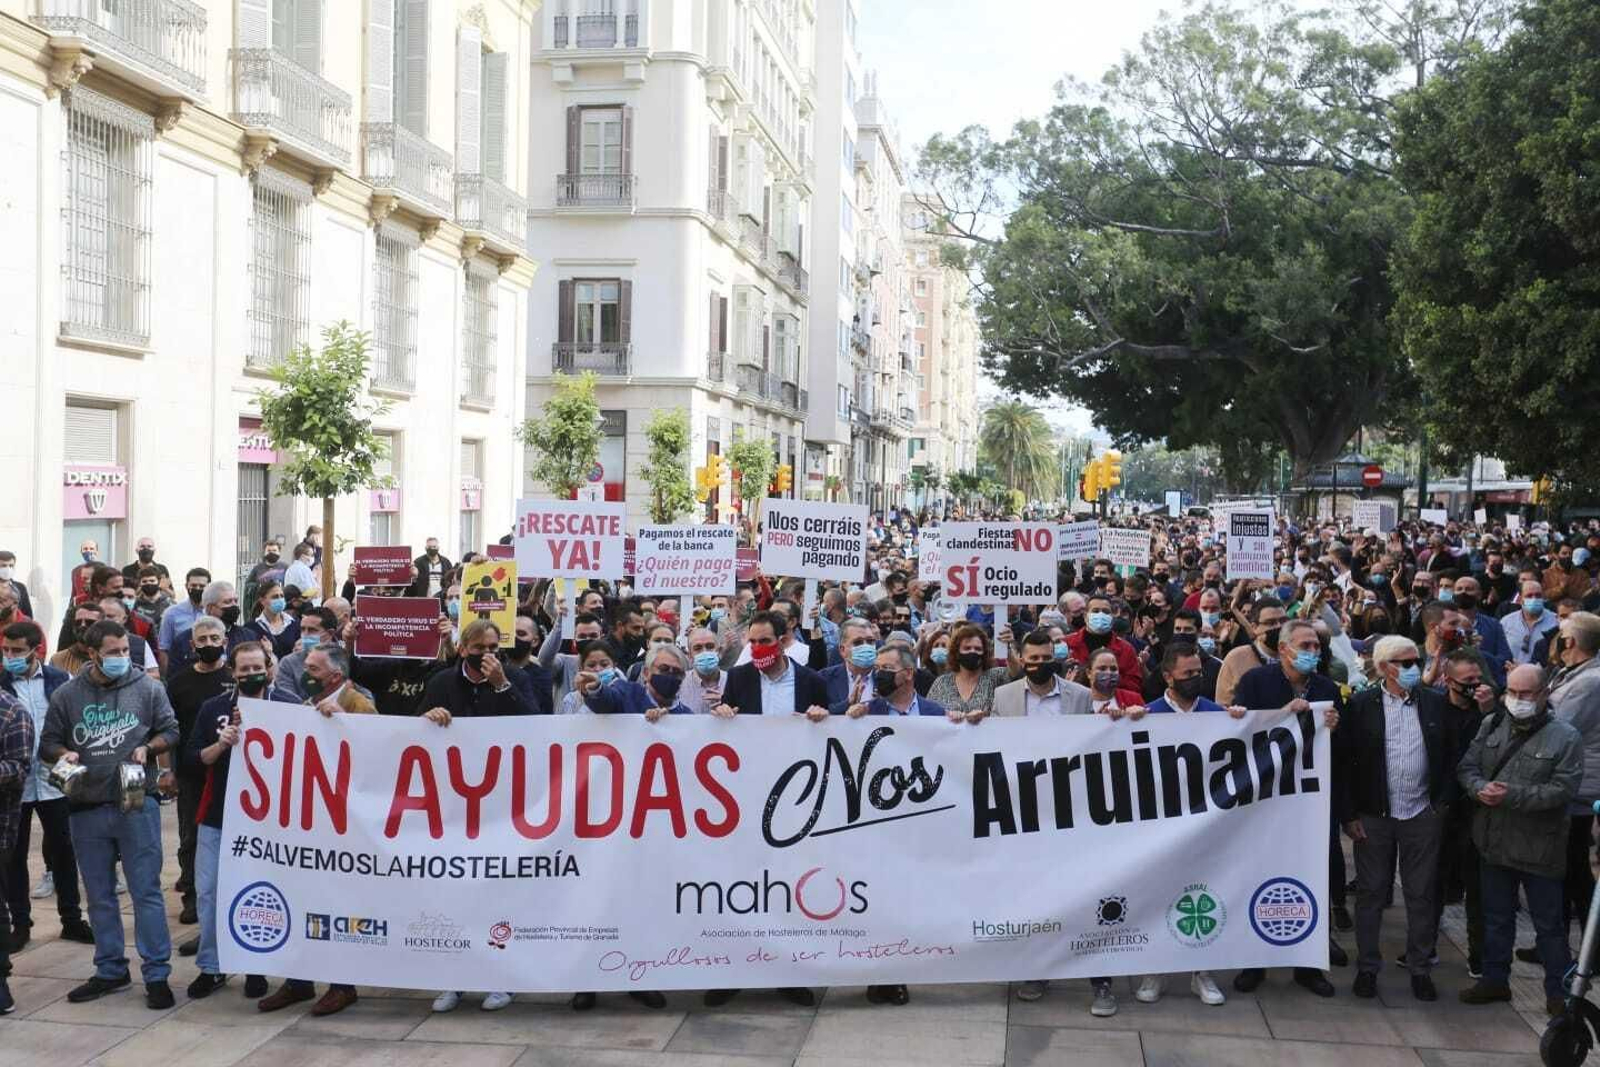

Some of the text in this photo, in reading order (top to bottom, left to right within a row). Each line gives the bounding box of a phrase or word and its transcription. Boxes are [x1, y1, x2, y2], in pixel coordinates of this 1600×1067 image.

[66, 471, 127, 485] DENTIX
[518, 513, 620, 538] ¡RESCATE
[768, 510, 861, 536] Nos cerráis
[1232, 523, 1268, 537] injustas
[639, 528, 734, 540] Pagamos el rescate
[767, 531, 860, 552] PERO seguimos
[978, 528, 1053, 552] Fiestas NO
[658, 541, 714, 550] de la banca
[946, 538, 1016, 550] clandestinas
[547, 539, 601, 571] YA!
[801, 551, 860, 568] pagando
[637, 556, 689, 574] ¿Quién
[693, 558, 732, 574] paga
[642, 573, 729, 588] el nuestro?
[946, 556, 1018, 597] SÍ Ocio
[984, 582, 1052, 600] regulado
[239, 710, 1321, 849] SIN AYUDAS Nos Arruinan!
[231, 835, 580, 879] #SALVEMOSLAHOSTELERÍA
[675, 866, 869, 921] mahos
[239, 907, 284, 923] HORECA
[1258, 905, 1307, 917] HORECA
[701, 928, 867, 938] Asociación de Hosteleros de Málaga
[972, 919, 1062, 937] Hosturjaén
[404, 937, 471, 950] HOSTECOR
[1070, 934, 1149, 951] HOSTELEROS
[598, 938, 955, 981] Orgullosos de ser hosteleros
